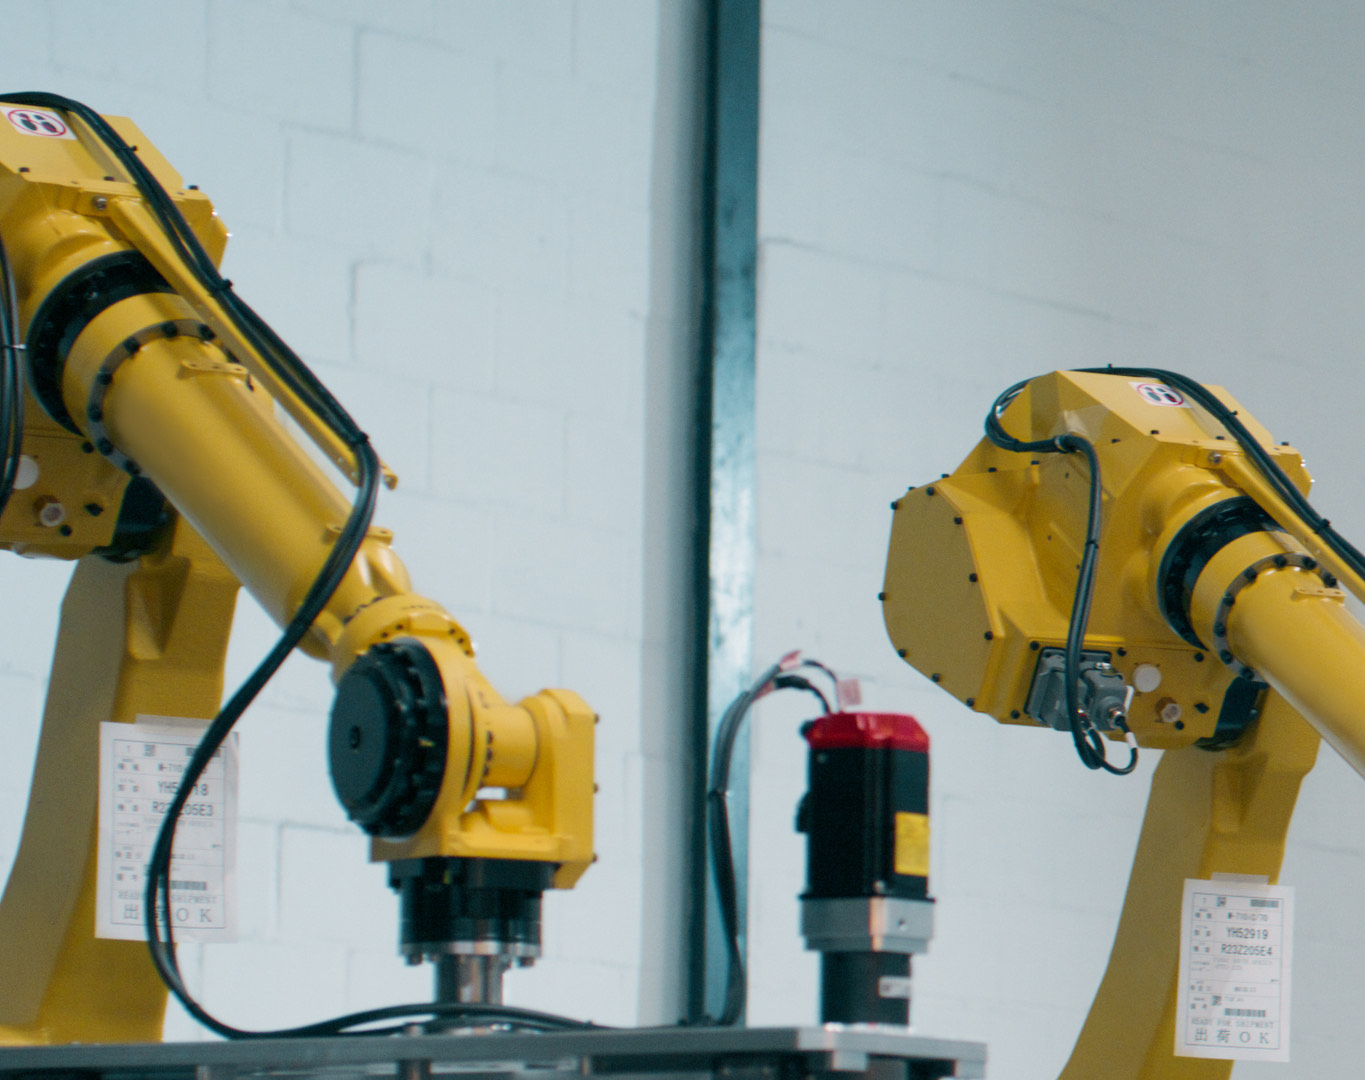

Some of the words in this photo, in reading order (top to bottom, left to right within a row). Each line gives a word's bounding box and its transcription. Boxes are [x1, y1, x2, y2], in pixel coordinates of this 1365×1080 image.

[158, 781, 209, 796] YH518
[151, 801, 214, 817] R205E3
[1226, 927, 1268, 939] YH52919
